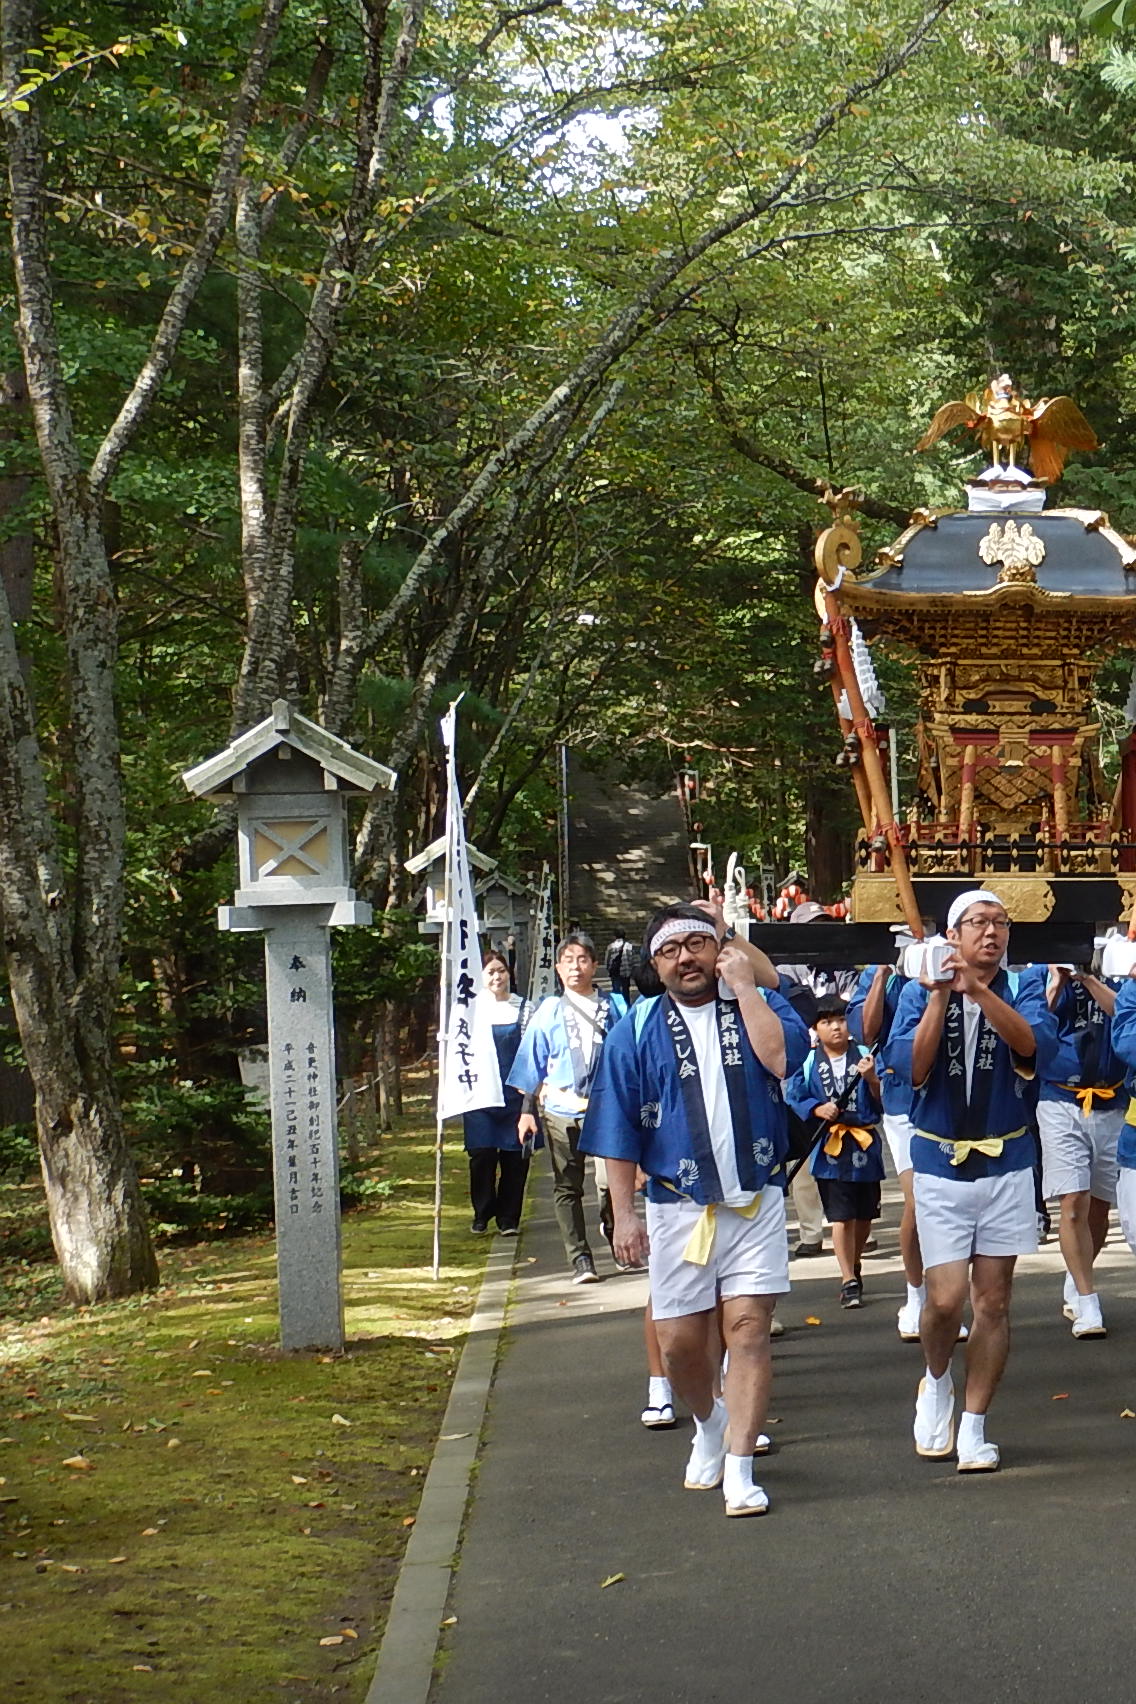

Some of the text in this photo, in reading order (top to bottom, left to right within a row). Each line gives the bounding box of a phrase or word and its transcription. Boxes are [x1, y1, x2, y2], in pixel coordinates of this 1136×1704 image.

[667, 1010, 698, 1080] みこし会
[946, 1003, 964, 1077] みこし会
